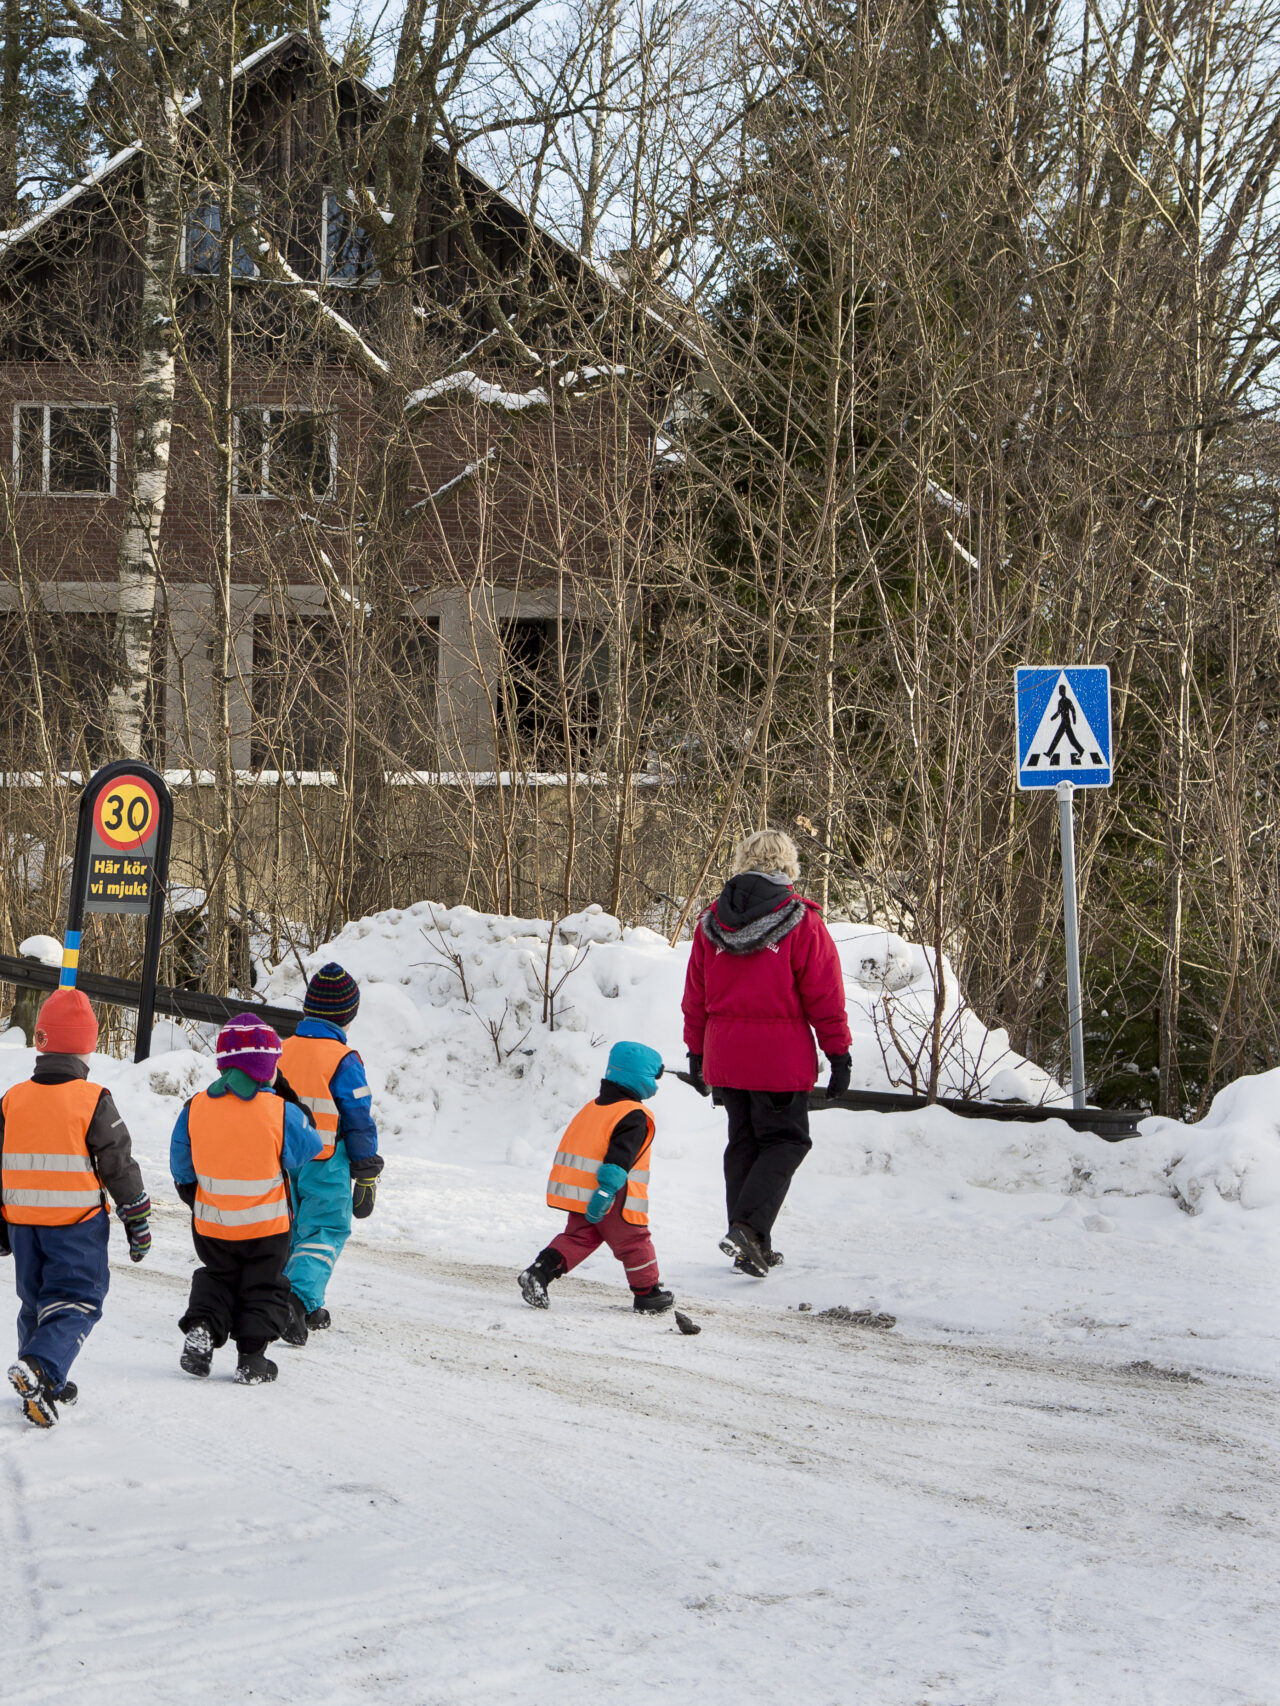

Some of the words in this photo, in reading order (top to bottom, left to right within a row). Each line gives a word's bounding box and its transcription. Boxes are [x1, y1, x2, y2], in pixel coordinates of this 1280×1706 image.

[104, 794, 150, 832] 30
[94, 860, 120, 875] Här
[123, 860, 148, 876] kör
[90, 880, 103, 895] vi
[106, 880, 148, 899] mjukt
